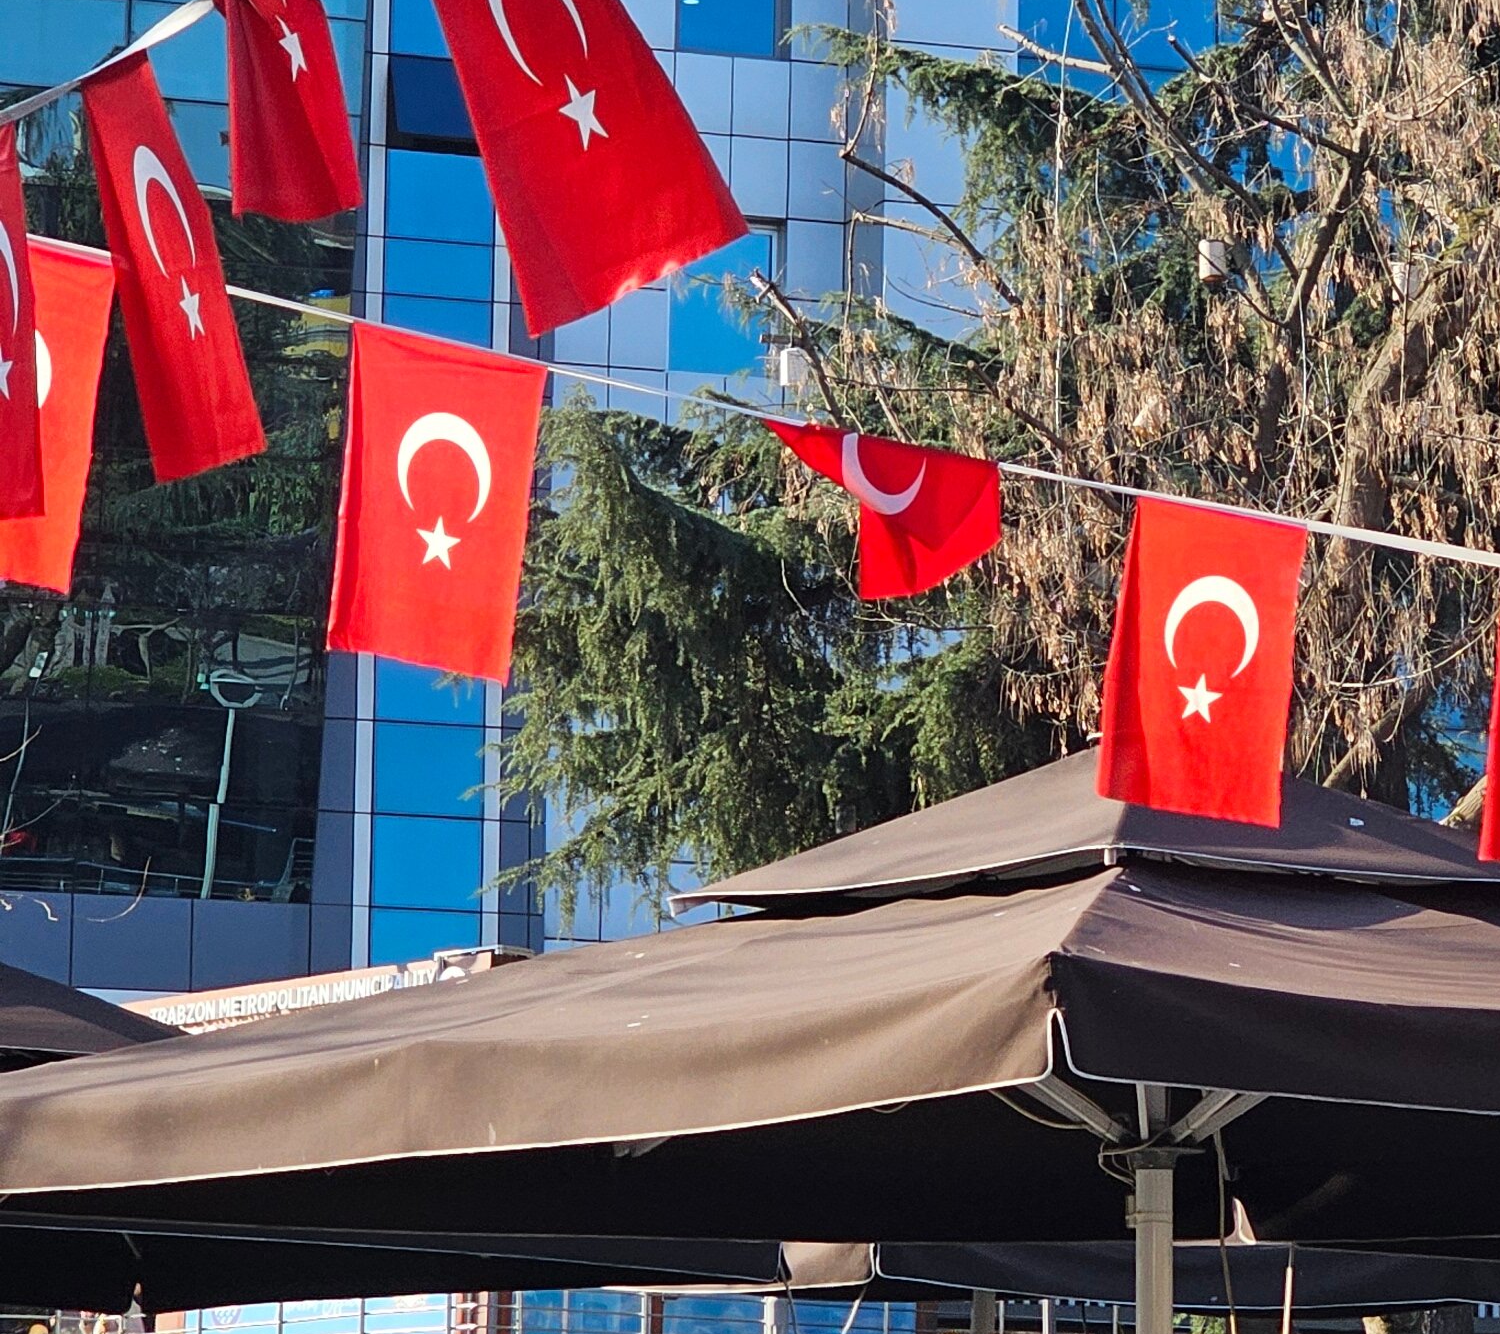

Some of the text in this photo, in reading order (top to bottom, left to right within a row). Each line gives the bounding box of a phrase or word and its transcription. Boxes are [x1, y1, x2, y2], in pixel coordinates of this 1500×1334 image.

[150, 968, 437, 1025] TRABZON METROPOLITAN MUNICIPALITY
